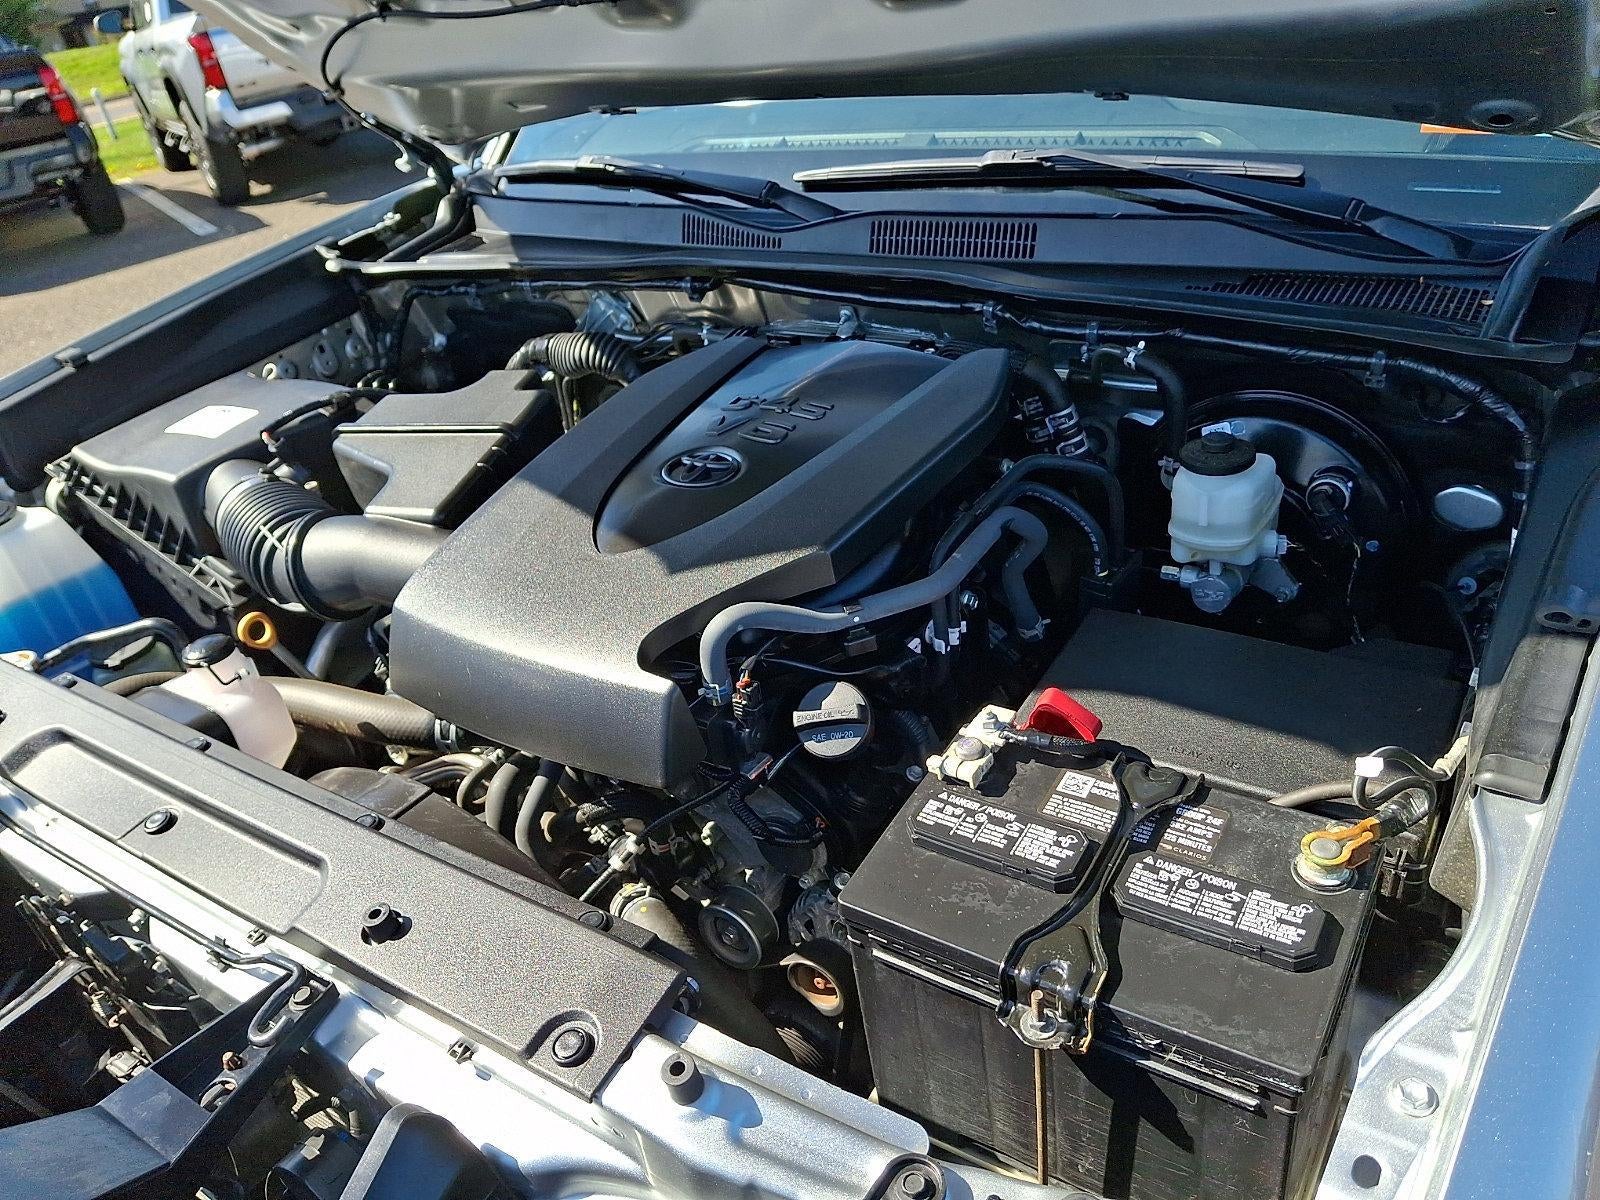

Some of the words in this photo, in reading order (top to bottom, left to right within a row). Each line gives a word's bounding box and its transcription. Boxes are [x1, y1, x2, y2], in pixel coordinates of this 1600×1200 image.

[797, 712, 823, 723] ENGINE
[811, 733, 827, 741] SAE
[830, 730, 854, 740] 0W-20
[948, 794, 981, 811] DANGER
[986, 805, 1017, 822] POISON
[1205, 815, 1225, 826] 24F
[1186, 825, 1214, 839] AMPS
[1177, 836, 1213, 853] MINUTES
[1173, 847, 1208, 861] CLARIOS
[1155, 859, 1193, 878] DANGER
[1201, 873, 1238, 892] POISON
